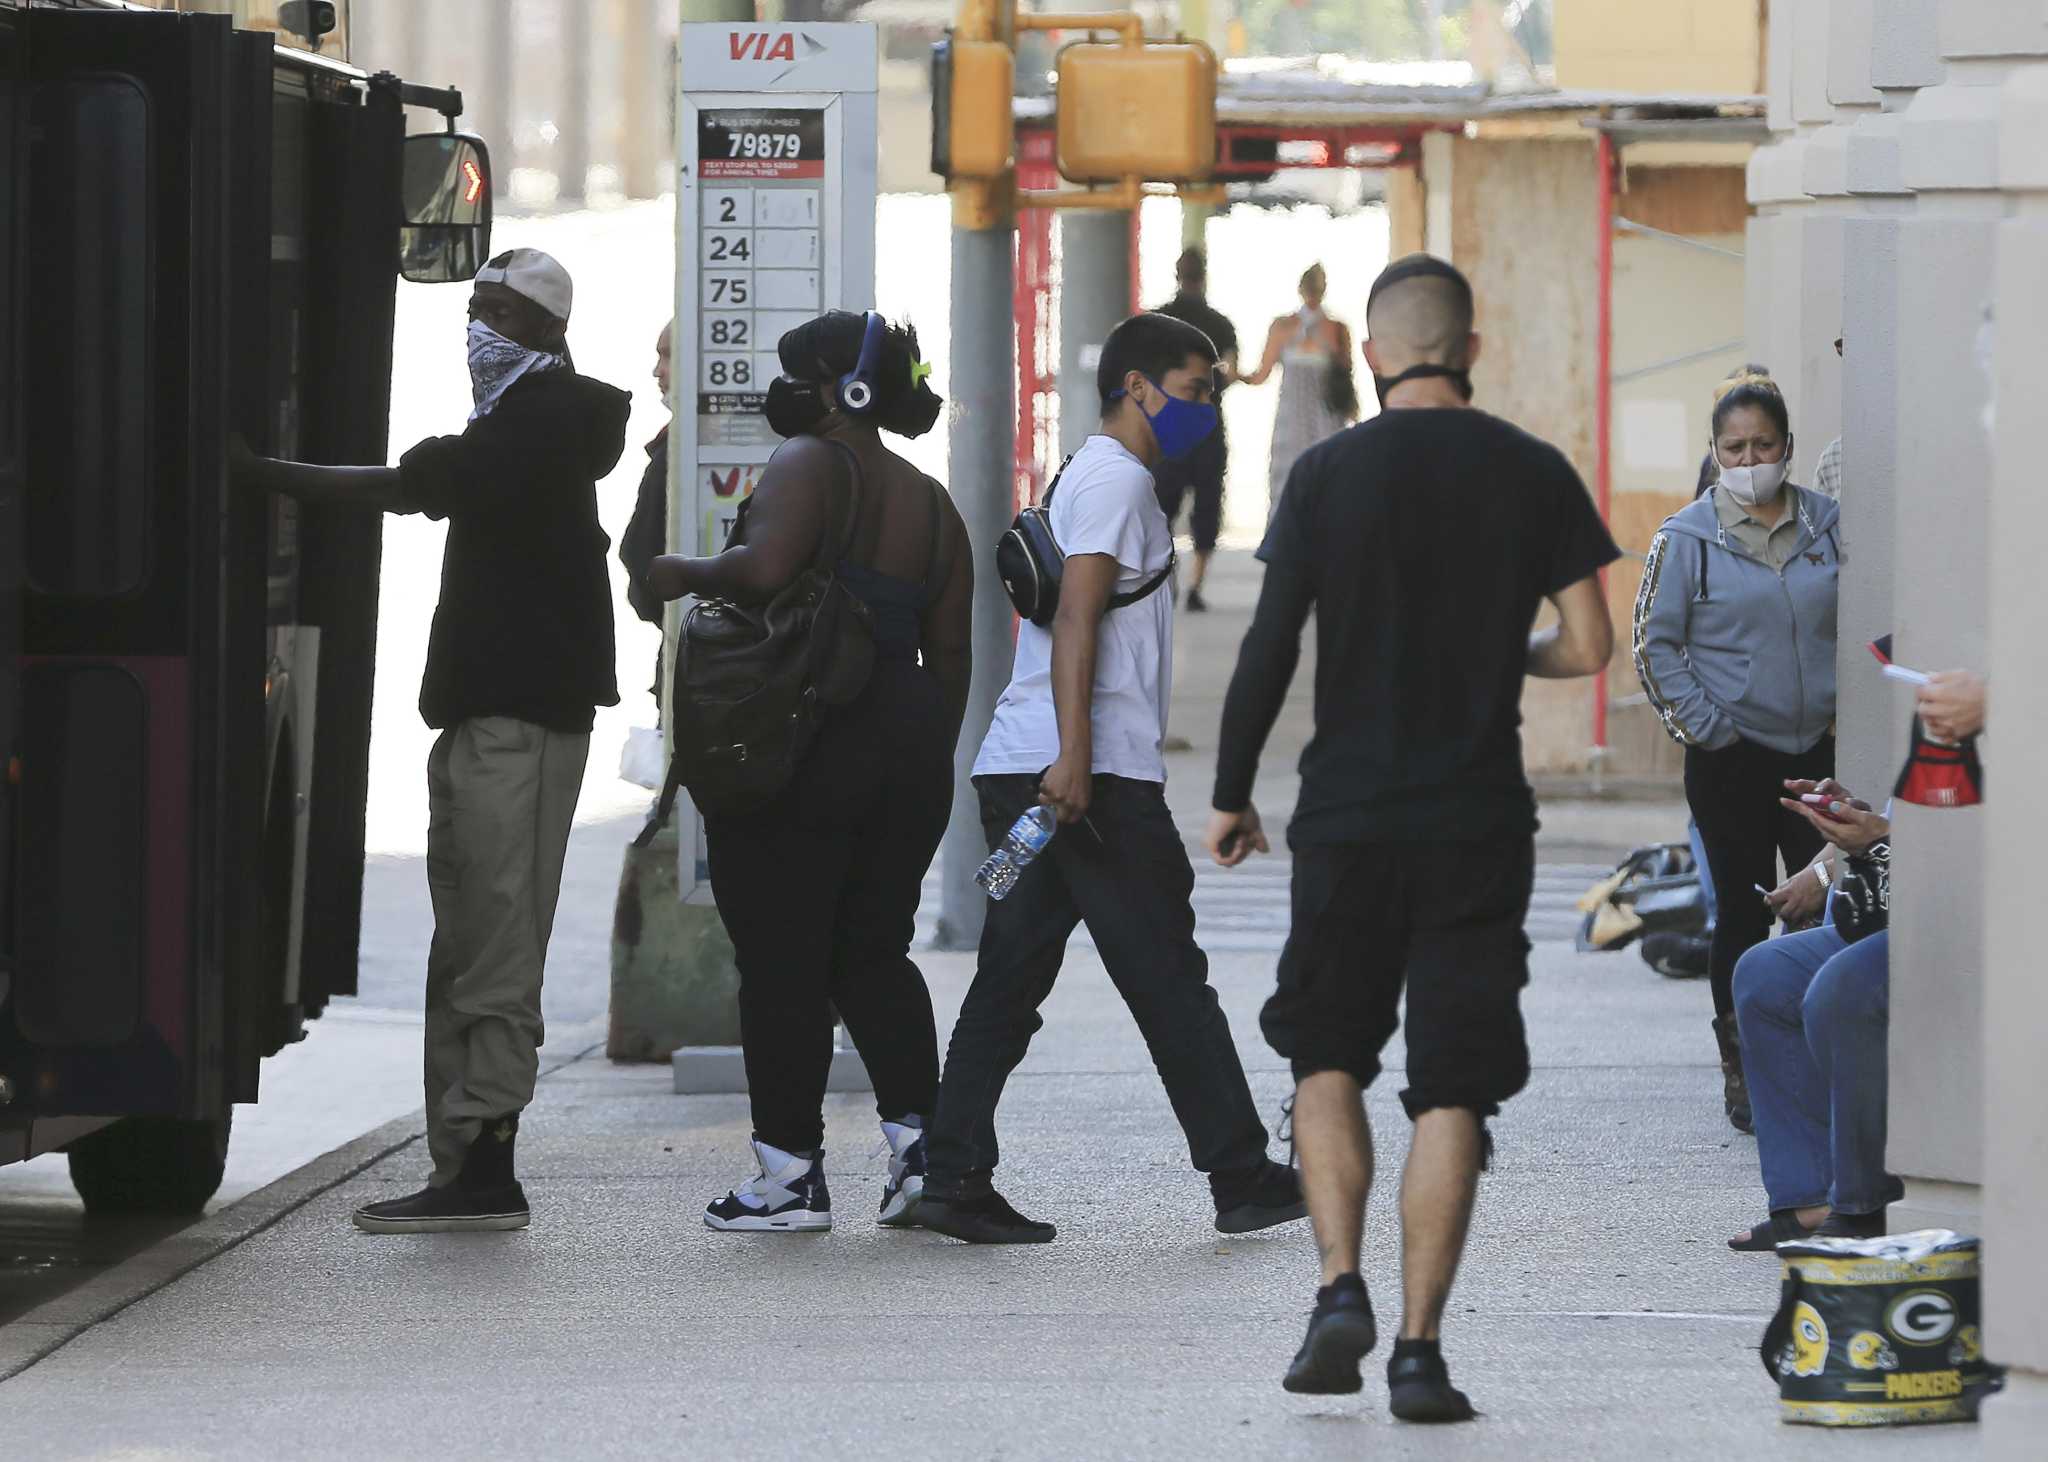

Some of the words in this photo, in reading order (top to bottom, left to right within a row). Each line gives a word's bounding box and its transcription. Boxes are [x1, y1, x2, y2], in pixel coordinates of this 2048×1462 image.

[729, 32, 795, 61] VIA
[728, 132, 801, 159] 79879
[725, 161, 745, 169] STOP
[720, 196, 736, 222] 2
[709, 235, 750, 261] 24
[710, 278, 747, 304] 75
[711, 319, 748, 345] 82
[709, 359, 751, 385] 88
[1891, 1293, 1956, 1342] G
[1885, 1370, 1962, 1400] PACKERS
